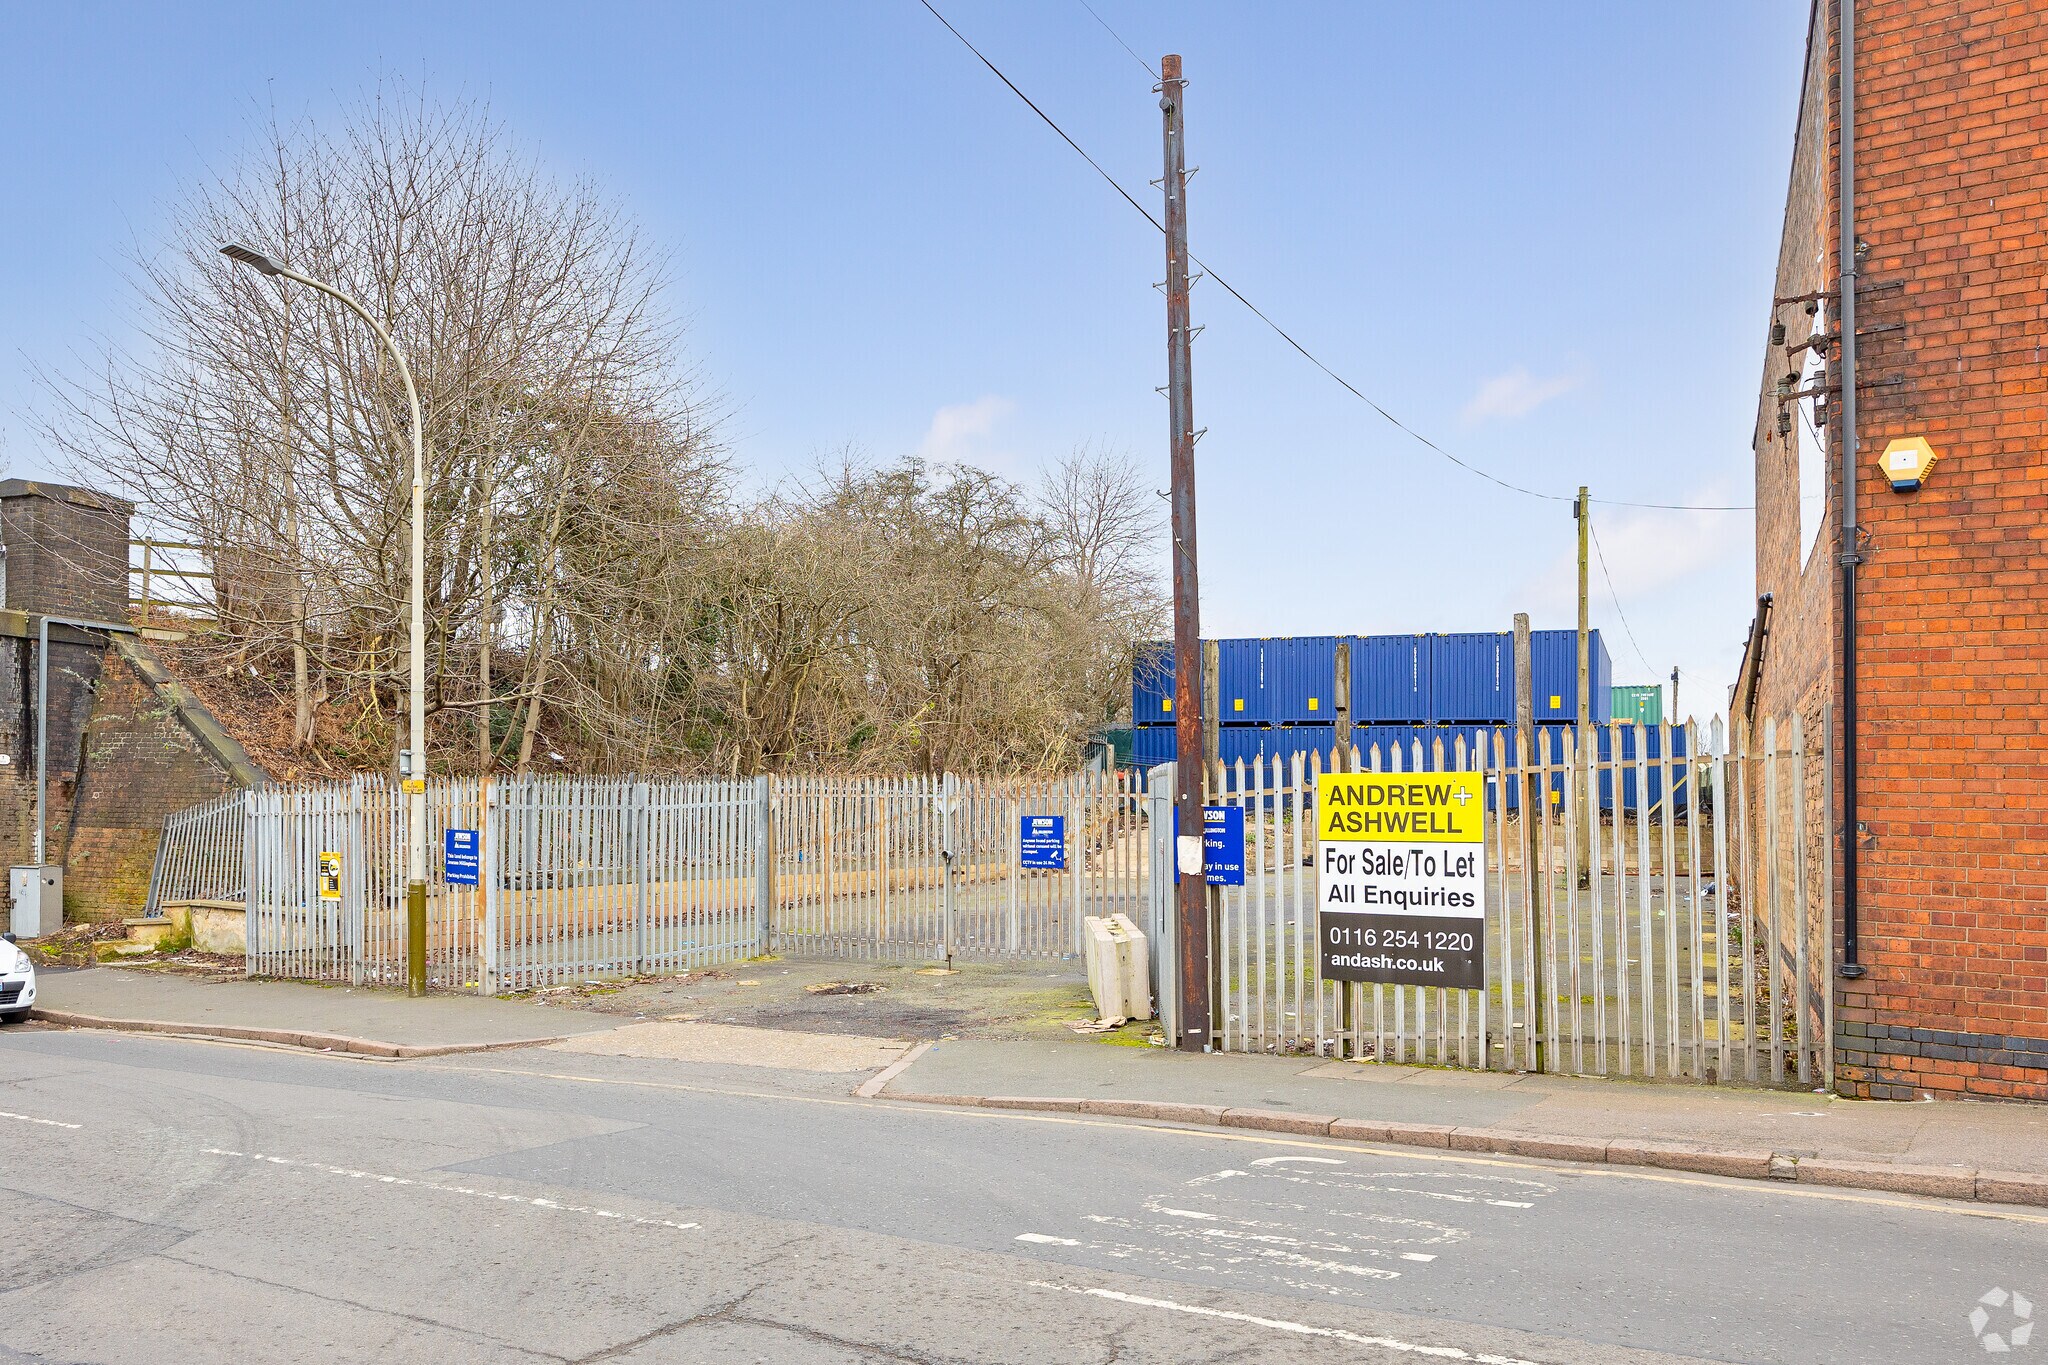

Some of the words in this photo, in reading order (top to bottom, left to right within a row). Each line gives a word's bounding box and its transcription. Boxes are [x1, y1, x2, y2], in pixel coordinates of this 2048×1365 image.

[1328, 811, 1463, 834] ASHWELL
[1215, 862, 1223, 870] in
[1326, 848, 1356, 874] For
[1362, 848, 1436, 879] Sale/To
[1444, 850, 1475, 878] Let
[1328, 884, 1355, 903] All
[1364, 885, 1475, 910] Enquiries
[1329, 926, 1377, 946] 0116
[1382, 929, 1419, 949] 254
[1423, 931, 1474, 951] 1220
[1331, 952, 1444, 972] andash.co.uk
